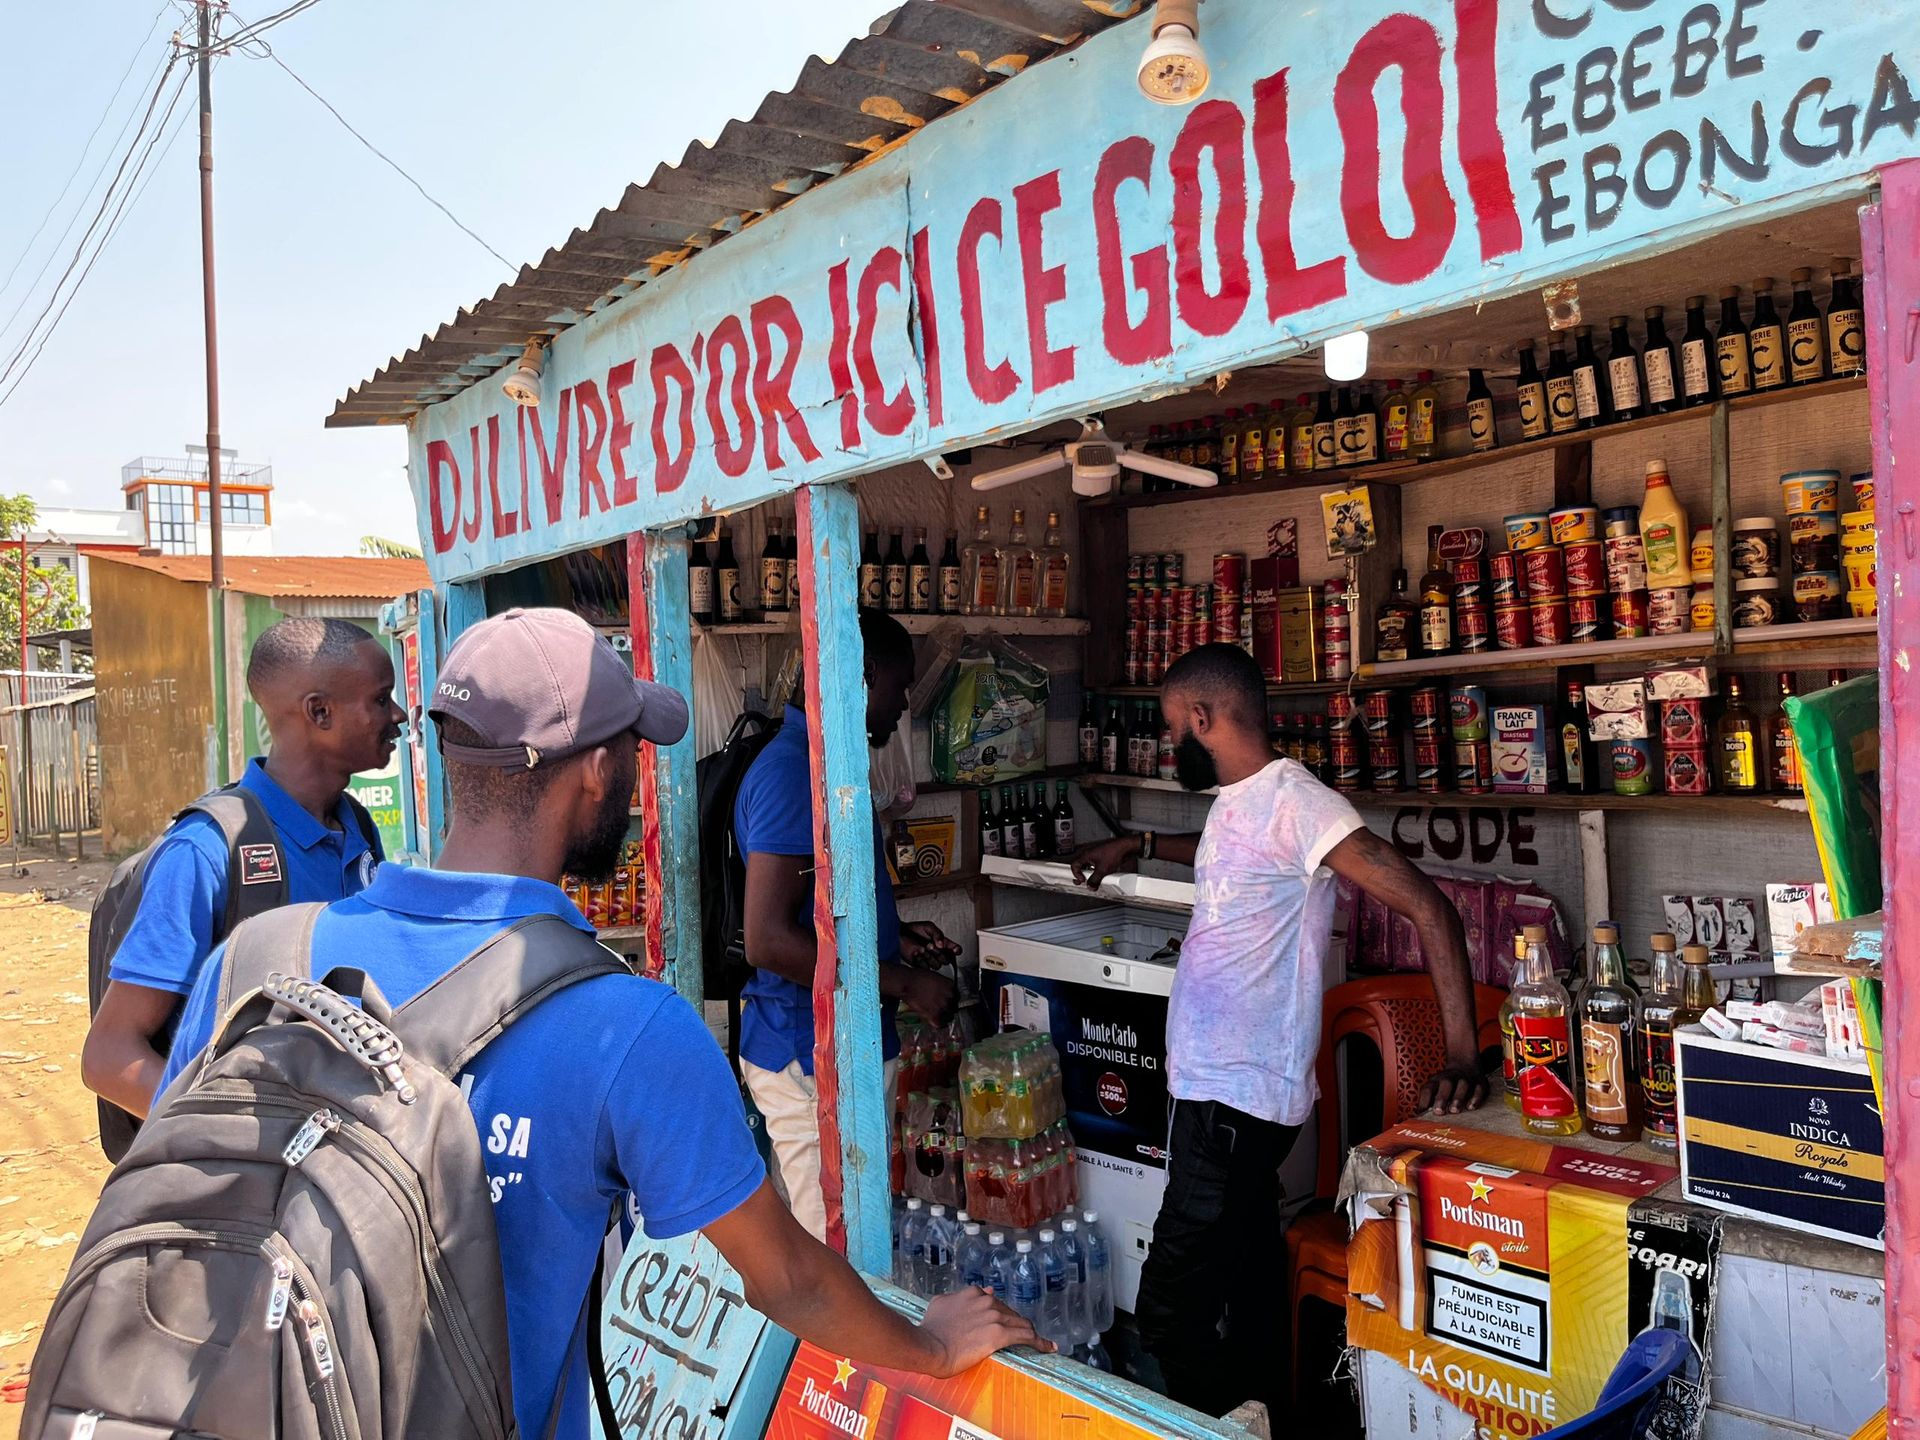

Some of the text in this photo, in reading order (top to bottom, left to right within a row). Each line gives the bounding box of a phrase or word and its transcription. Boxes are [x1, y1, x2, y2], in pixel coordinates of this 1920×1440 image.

[1788, 321, 1816, 335] CHERIE
[438, 682, 471, 701] POLO
[1497, 711, 1534, 720] FRANCE
[1505, 719, 1526, 729] LAIT
[1502, 731, 1530, 739] DIASTASE
[1391, 805, 1539, 865] CODE
[1771, 886, 1810, 903] Papia
[1066, 1041, 1157, 1070] DISPONIBLE ICI
[1808, 1116, 1831, 1126] NOVO
[487, 1112, 532, 1159] SA
[1789, 1122, 1851, 1147] INDICA
[1794, 1142, 1849, 1169] Royale
[1586, 1161, 1643, 1177] TIGES
[1798, 1171, 1847, 1190] Malt Whisky
[1693, 1184, 1715, 1197] 250ml
[1721, 1191, 1731, 1200] 24
[1440, 1195, 1526, 1239] Portsman
[1451, 1285, 1520, 1316] FUMER EST
[1438, 1297, 1536, 1338] PRÉJUDICIABLE
[1449, 1315, 1522, 1350] À LA SANTÉ
[1408, 1348, 1439, 1382] LA
[1442, 1363, 1557, 1421] QUALITÉ
[798, 1376, 870, 1440] Portsman
